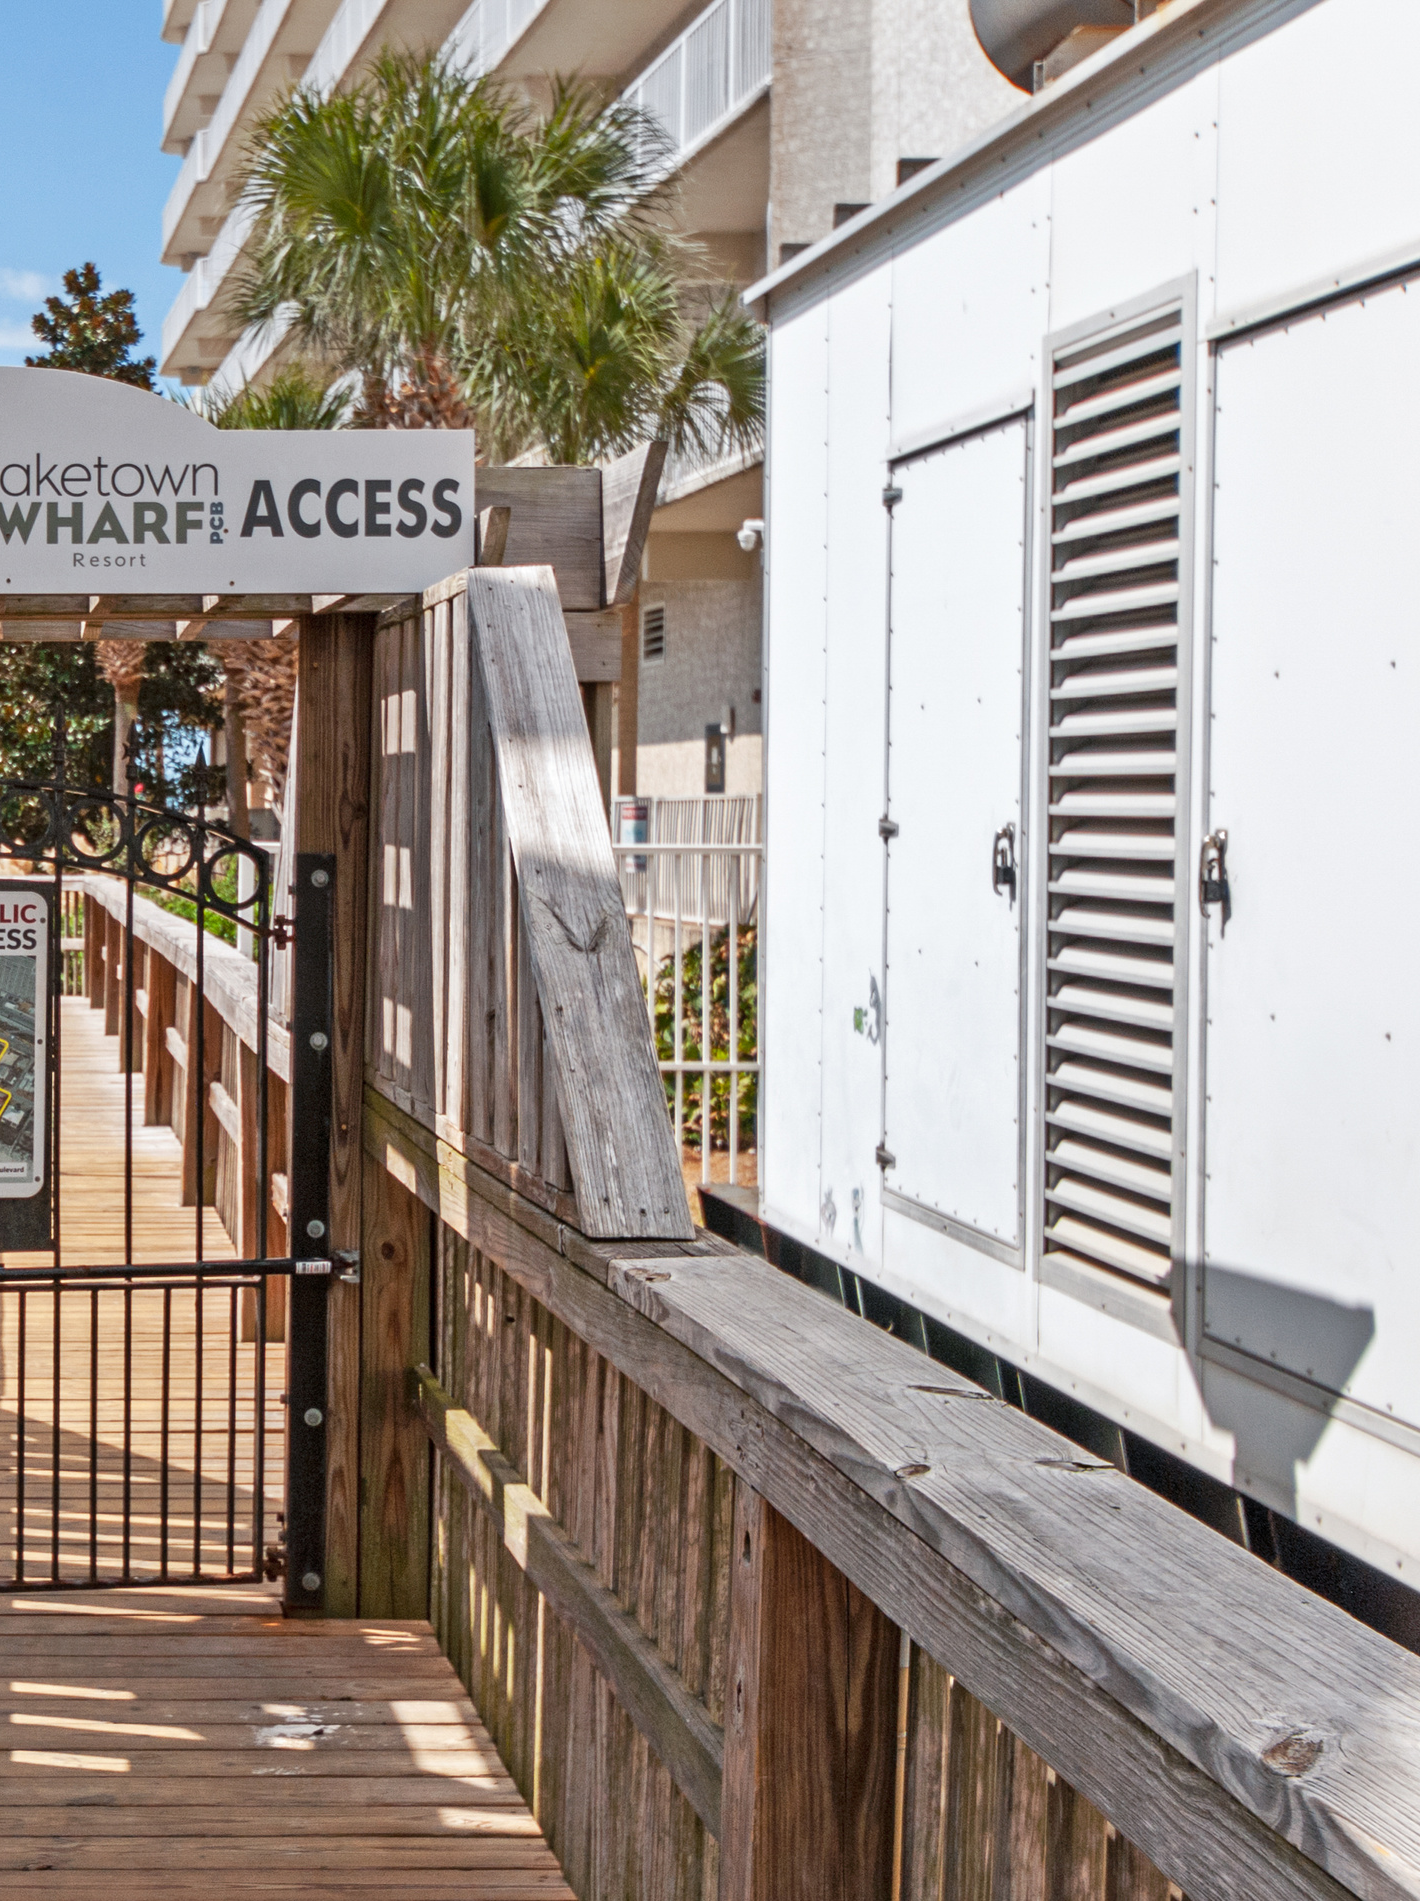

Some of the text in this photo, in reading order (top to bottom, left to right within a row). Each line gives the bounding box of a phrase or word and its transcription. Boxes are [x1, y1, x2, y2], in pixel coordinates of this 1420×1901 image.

[209, 501, 224, 545] PCB
[240, 478, 462, 539] ACCESS
[72, 552, 147, 568] Resort
